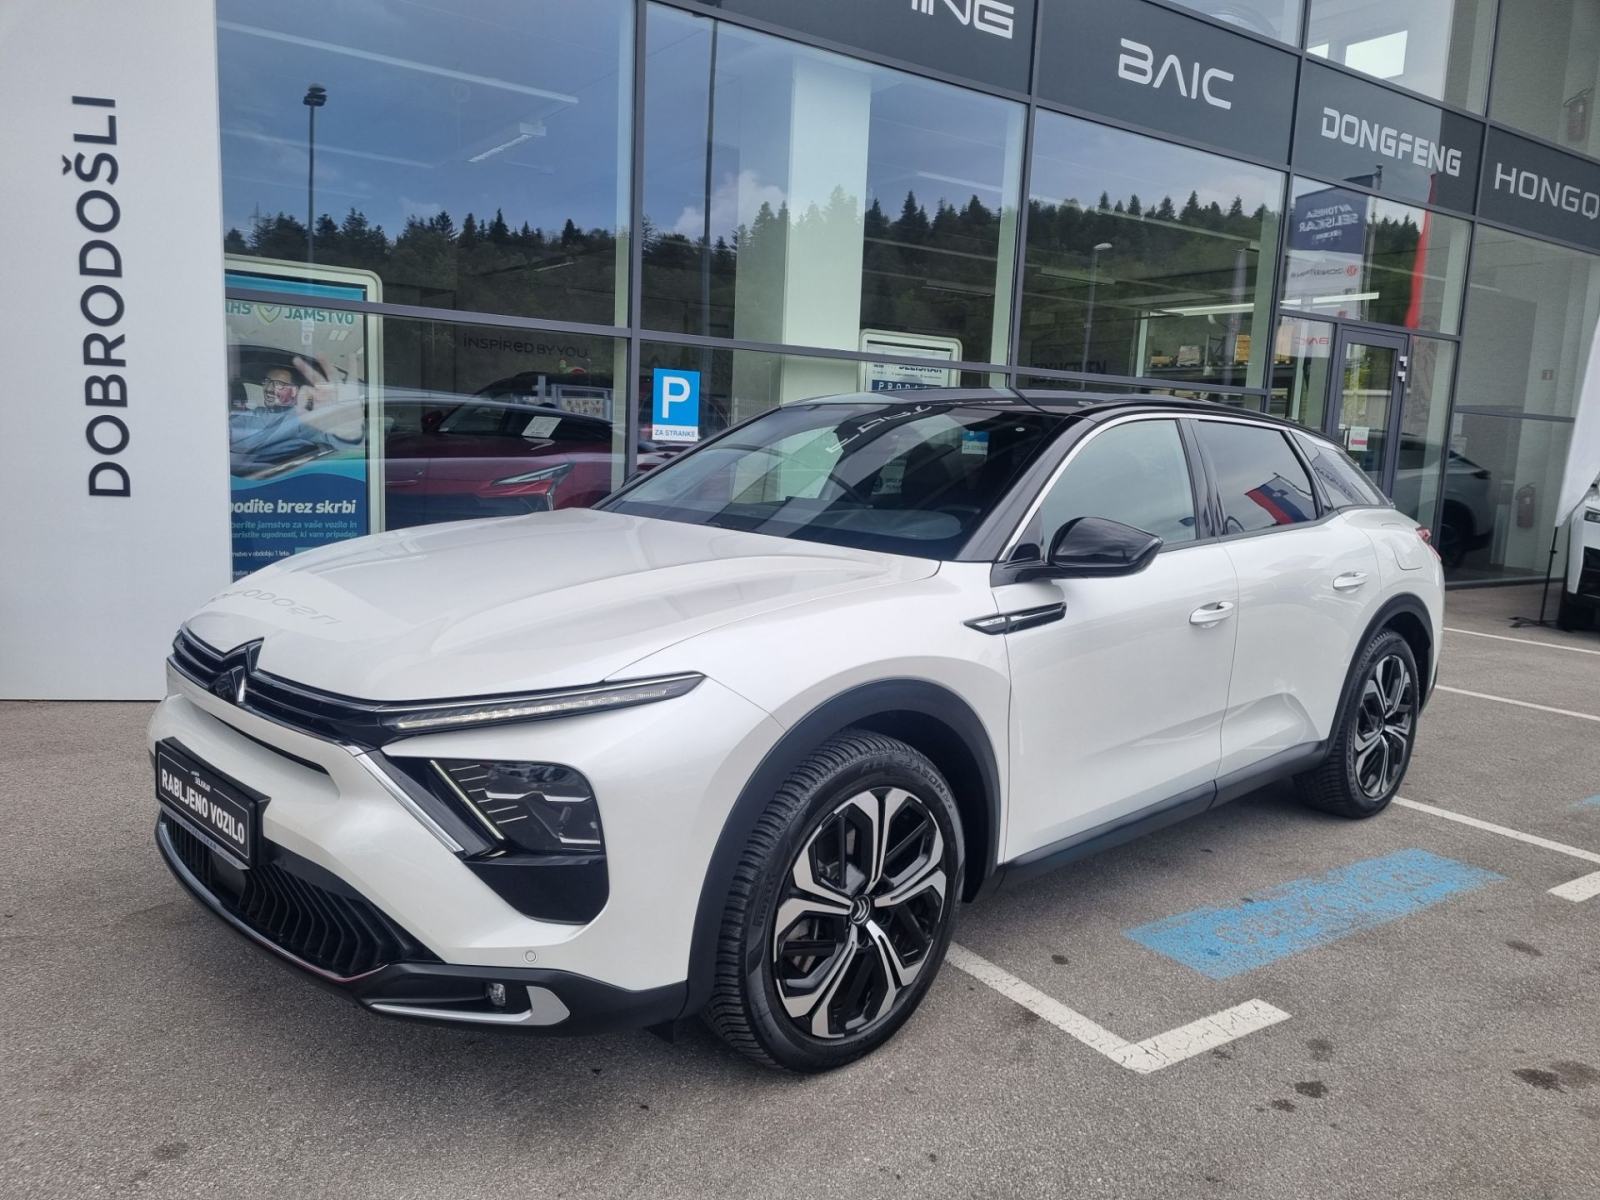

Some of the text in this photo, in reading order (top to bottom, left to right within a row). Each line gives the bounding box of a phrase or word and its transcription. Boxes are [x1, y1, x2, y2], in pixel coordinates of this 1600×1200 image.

[911, 0, 1014, 39] NG
[1118, 37, 1234, 110] BAIC
[1320, 106, 1462, 177] DONGFENG
[1494, 162, 1600, 220] HONGQ
[62, 95, 131, 498] DOBRODOŠLI
[284, 307, 355, 325] JAMSTVO
[536, 343, 554, 356] BY
[559, 345, 589, 359] YOU
[662, 376, 691, 419] P
[665, 430, 696, 438] STRANKE
[257, 520, 291, 531] jamstvo
[325, 520, 348, 529] vozilo
[277, 499, 313, 514] brez
[316, 499, 357, 514] skrbi
[161, 768, 209, 818] RABLJENO
[209, 801, 245, 845] VOZILO
